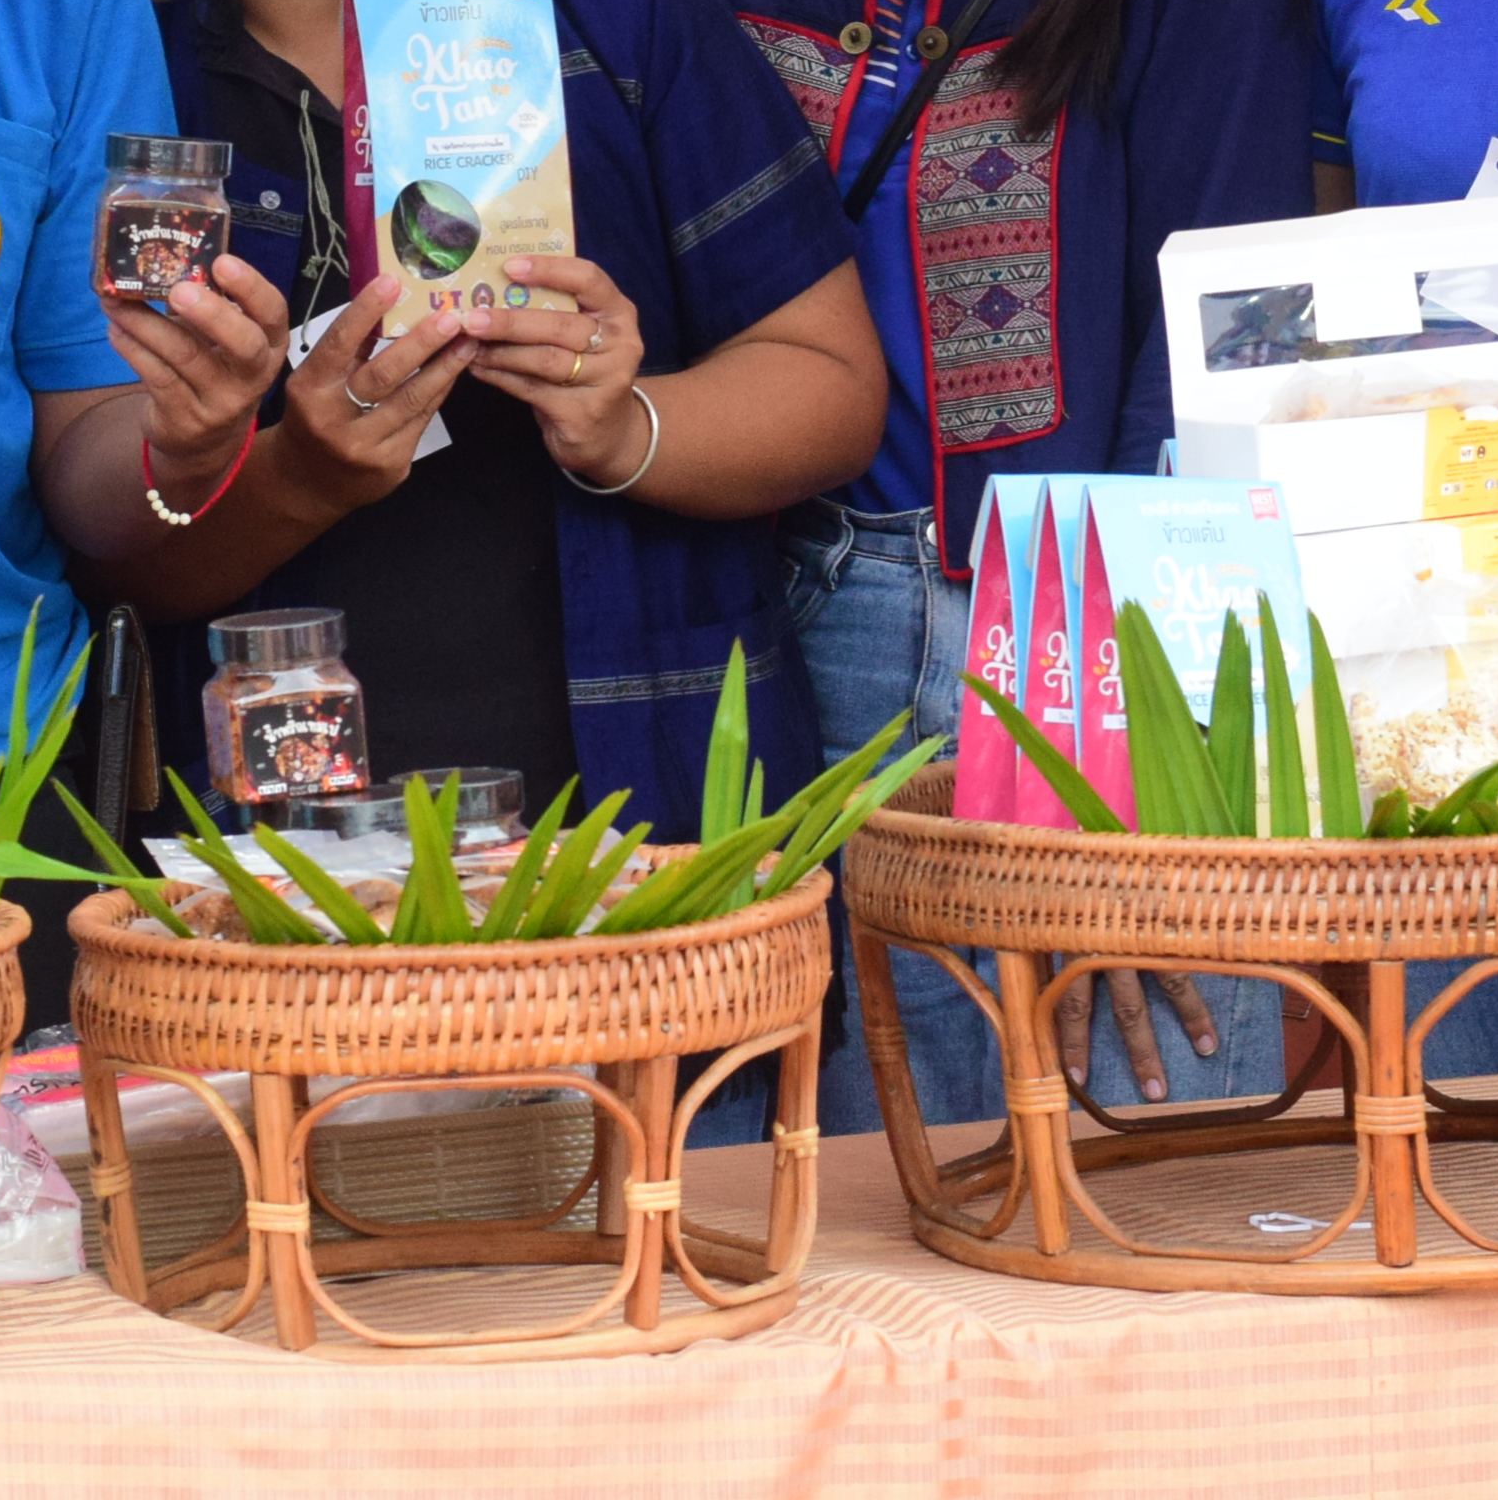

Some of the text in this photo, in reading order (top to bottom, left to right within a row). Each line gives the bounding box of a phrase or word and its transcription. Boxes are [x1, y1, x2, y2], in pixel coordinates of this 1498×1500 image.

[406, 32, 520, 84] Khao
[411, 83, 502, 131] Tan
[424, 153, 515, 170] RICE CRACKER
[517, 166, 539, 182] DIY
[1251, 493, 1274, 505] BEST
[1162, 520, 1225, 544] ข้าวแต๋น
[1186, 693, 1209, 707] ICE
